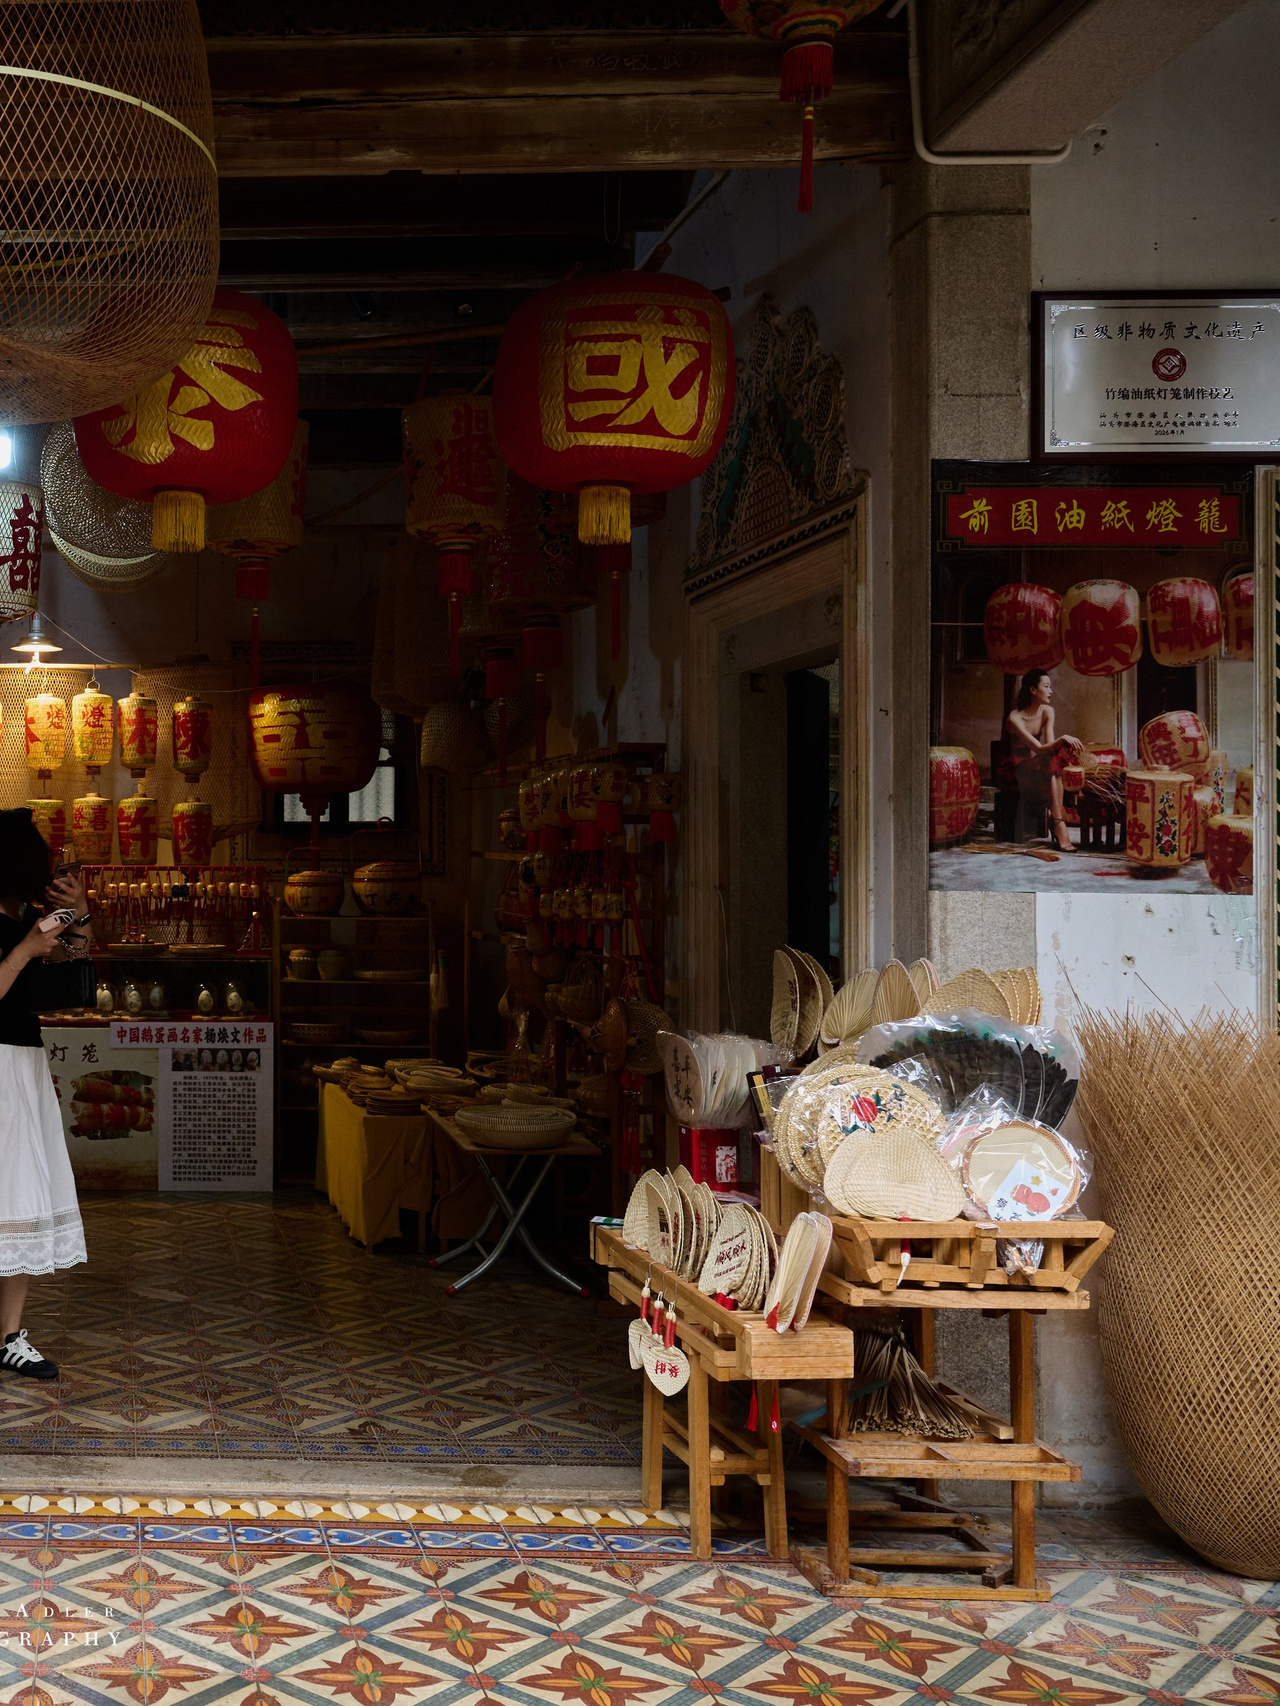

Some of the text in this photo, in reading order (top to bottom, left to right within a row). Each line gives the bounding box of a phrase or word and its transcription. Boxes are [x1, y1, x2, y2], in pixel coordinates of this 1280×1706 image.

[1072, 320, 1267, 342] 区级非物质文化遗产
[537, 291, 728, 459] 國
[1104, 386, 1235, 401] 竹编油纸灯笼制作技艺
[959, 497, 1228, 535] 前園油紙燈籠
[116, 1025, 267, 1045] 中国鹅蛋画名家杨焕文作品
